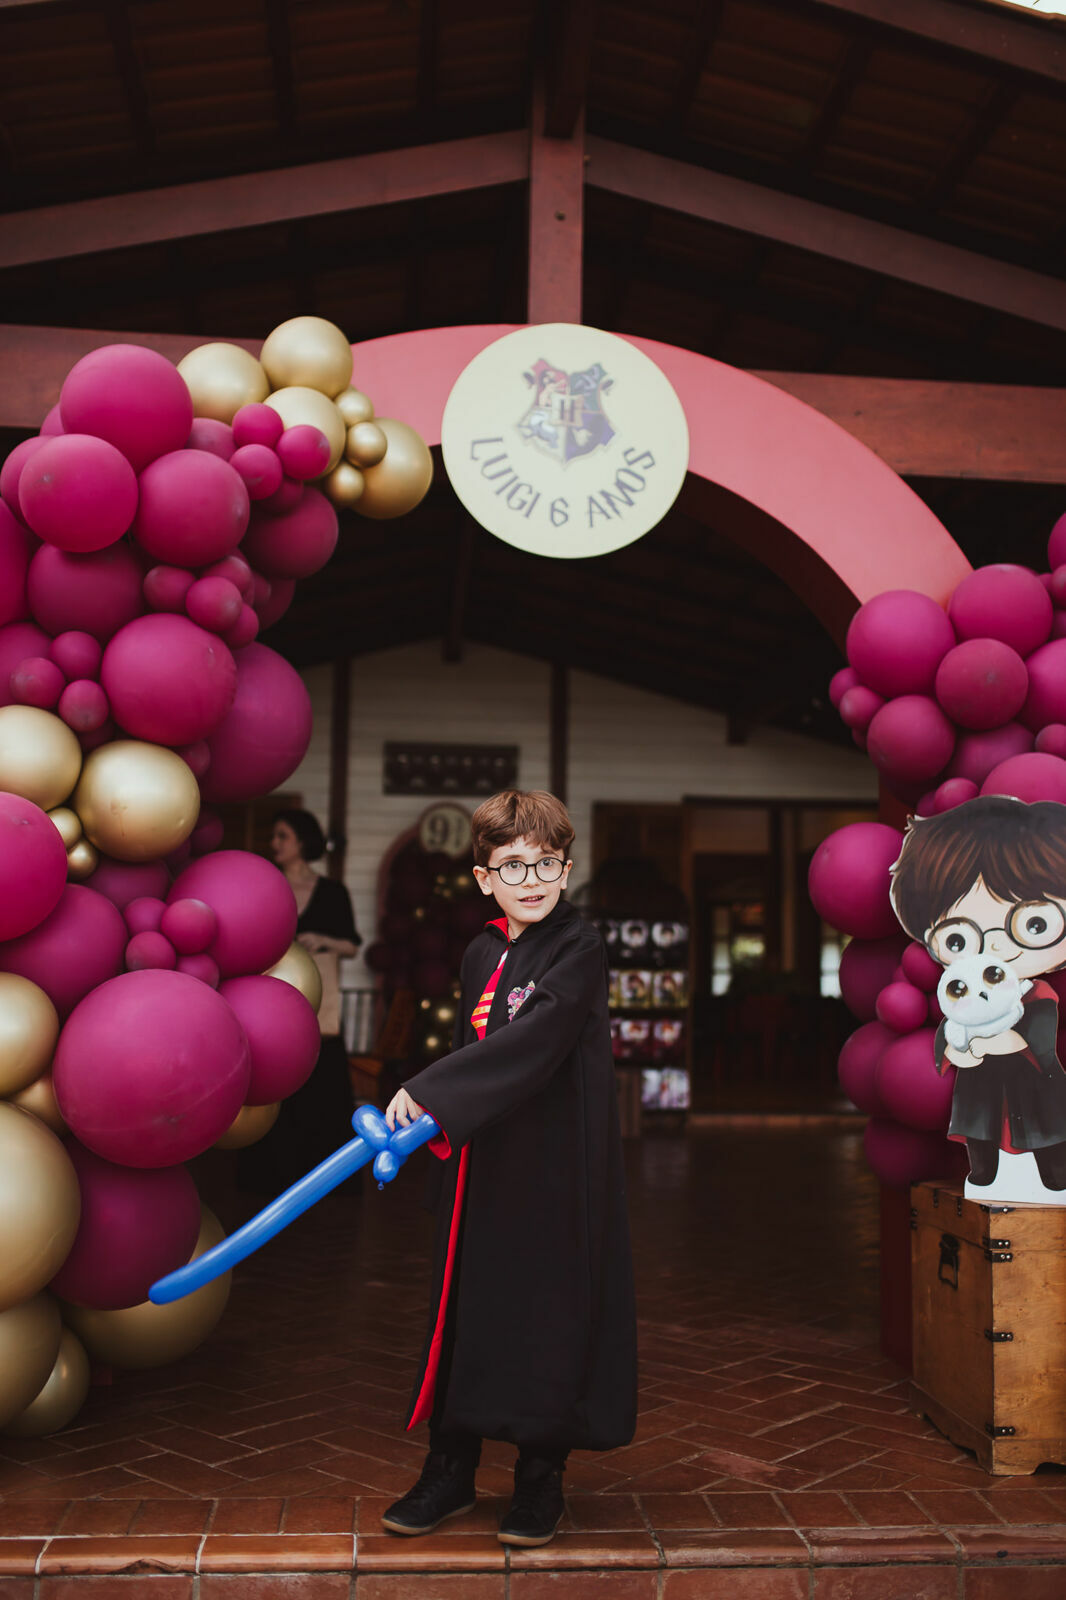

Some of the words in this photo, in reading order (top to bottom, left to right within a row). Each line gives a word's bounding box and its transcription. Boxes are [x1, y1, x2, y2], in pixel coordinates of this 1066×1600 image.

[470, 437, 541, 519] LUIGI
[550, 498, 569, 528] 6
[588, 447, 656, 528] ANOS
